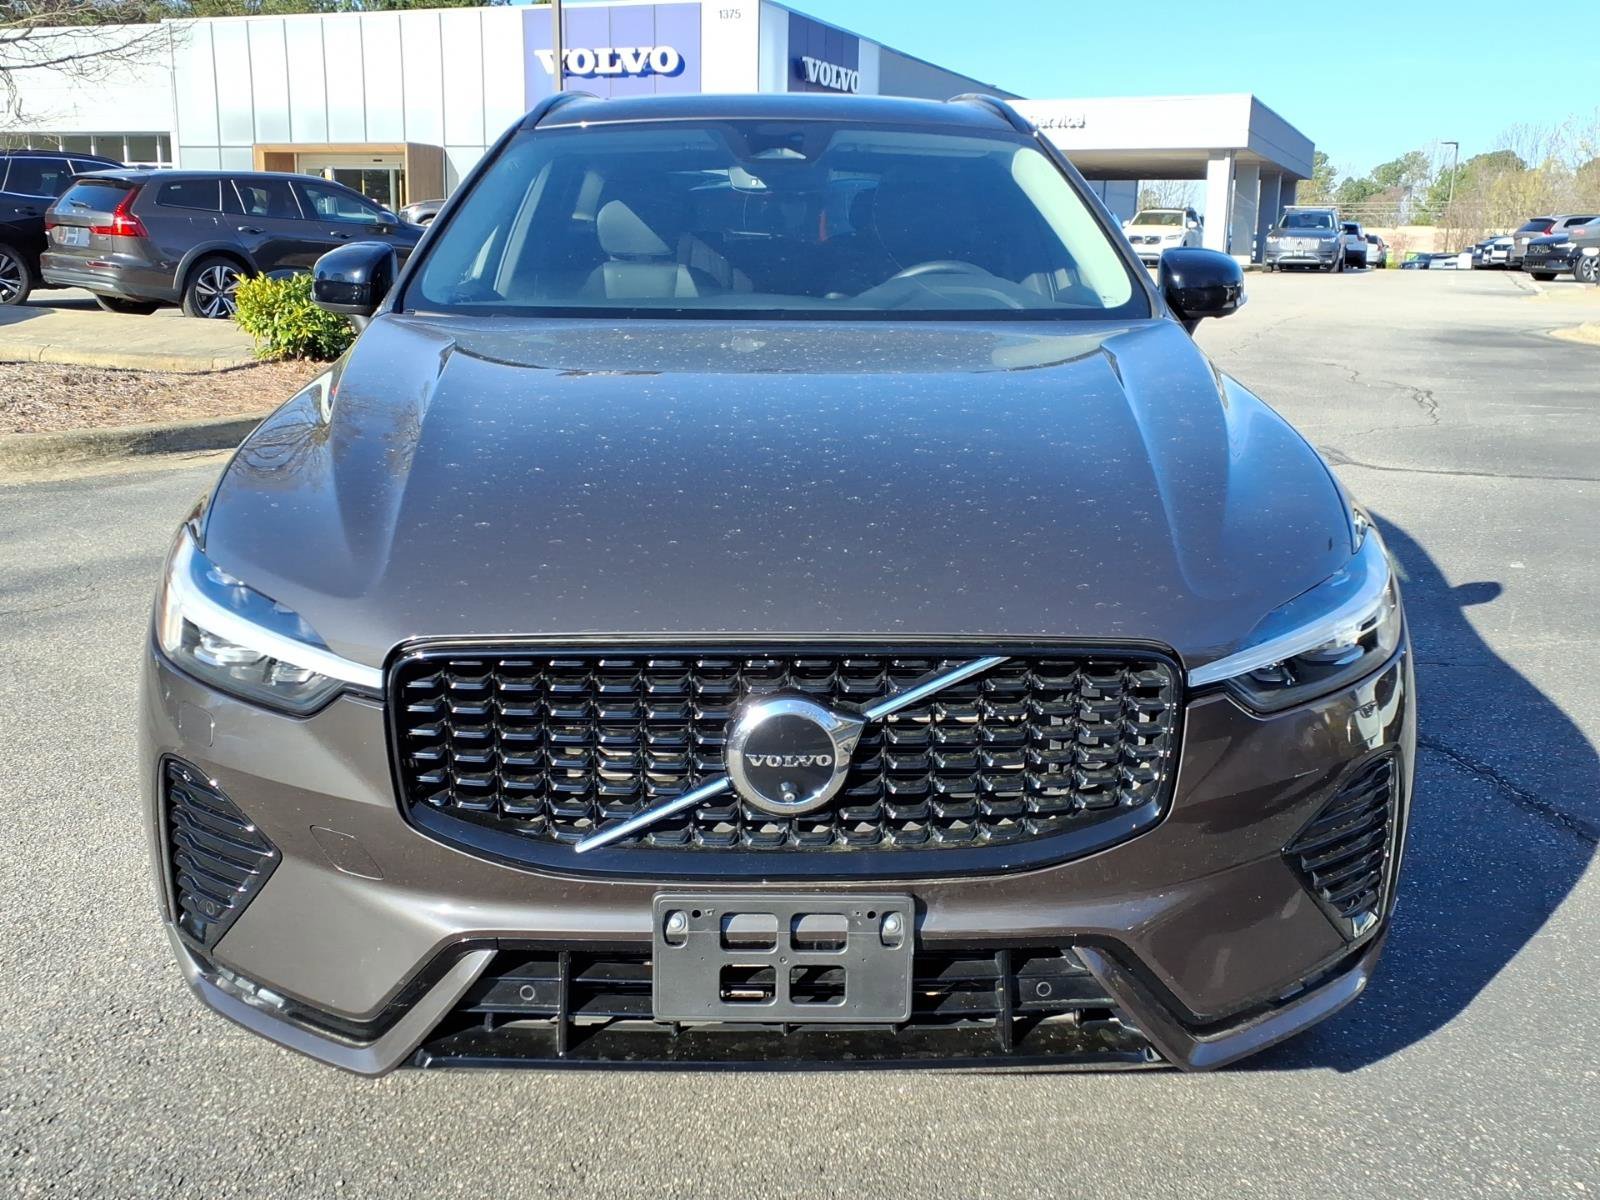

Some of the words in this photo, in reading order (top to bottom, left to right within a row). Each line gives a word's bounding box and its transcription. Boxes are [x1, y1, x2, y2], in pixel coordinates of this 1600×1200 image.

[719, 8, 741, 19] 1375
[534, 46, 679, 75] VOLVO
[802, 56, 860, 94] VOLVO
[745, 753, 832, 767] VOLVO
